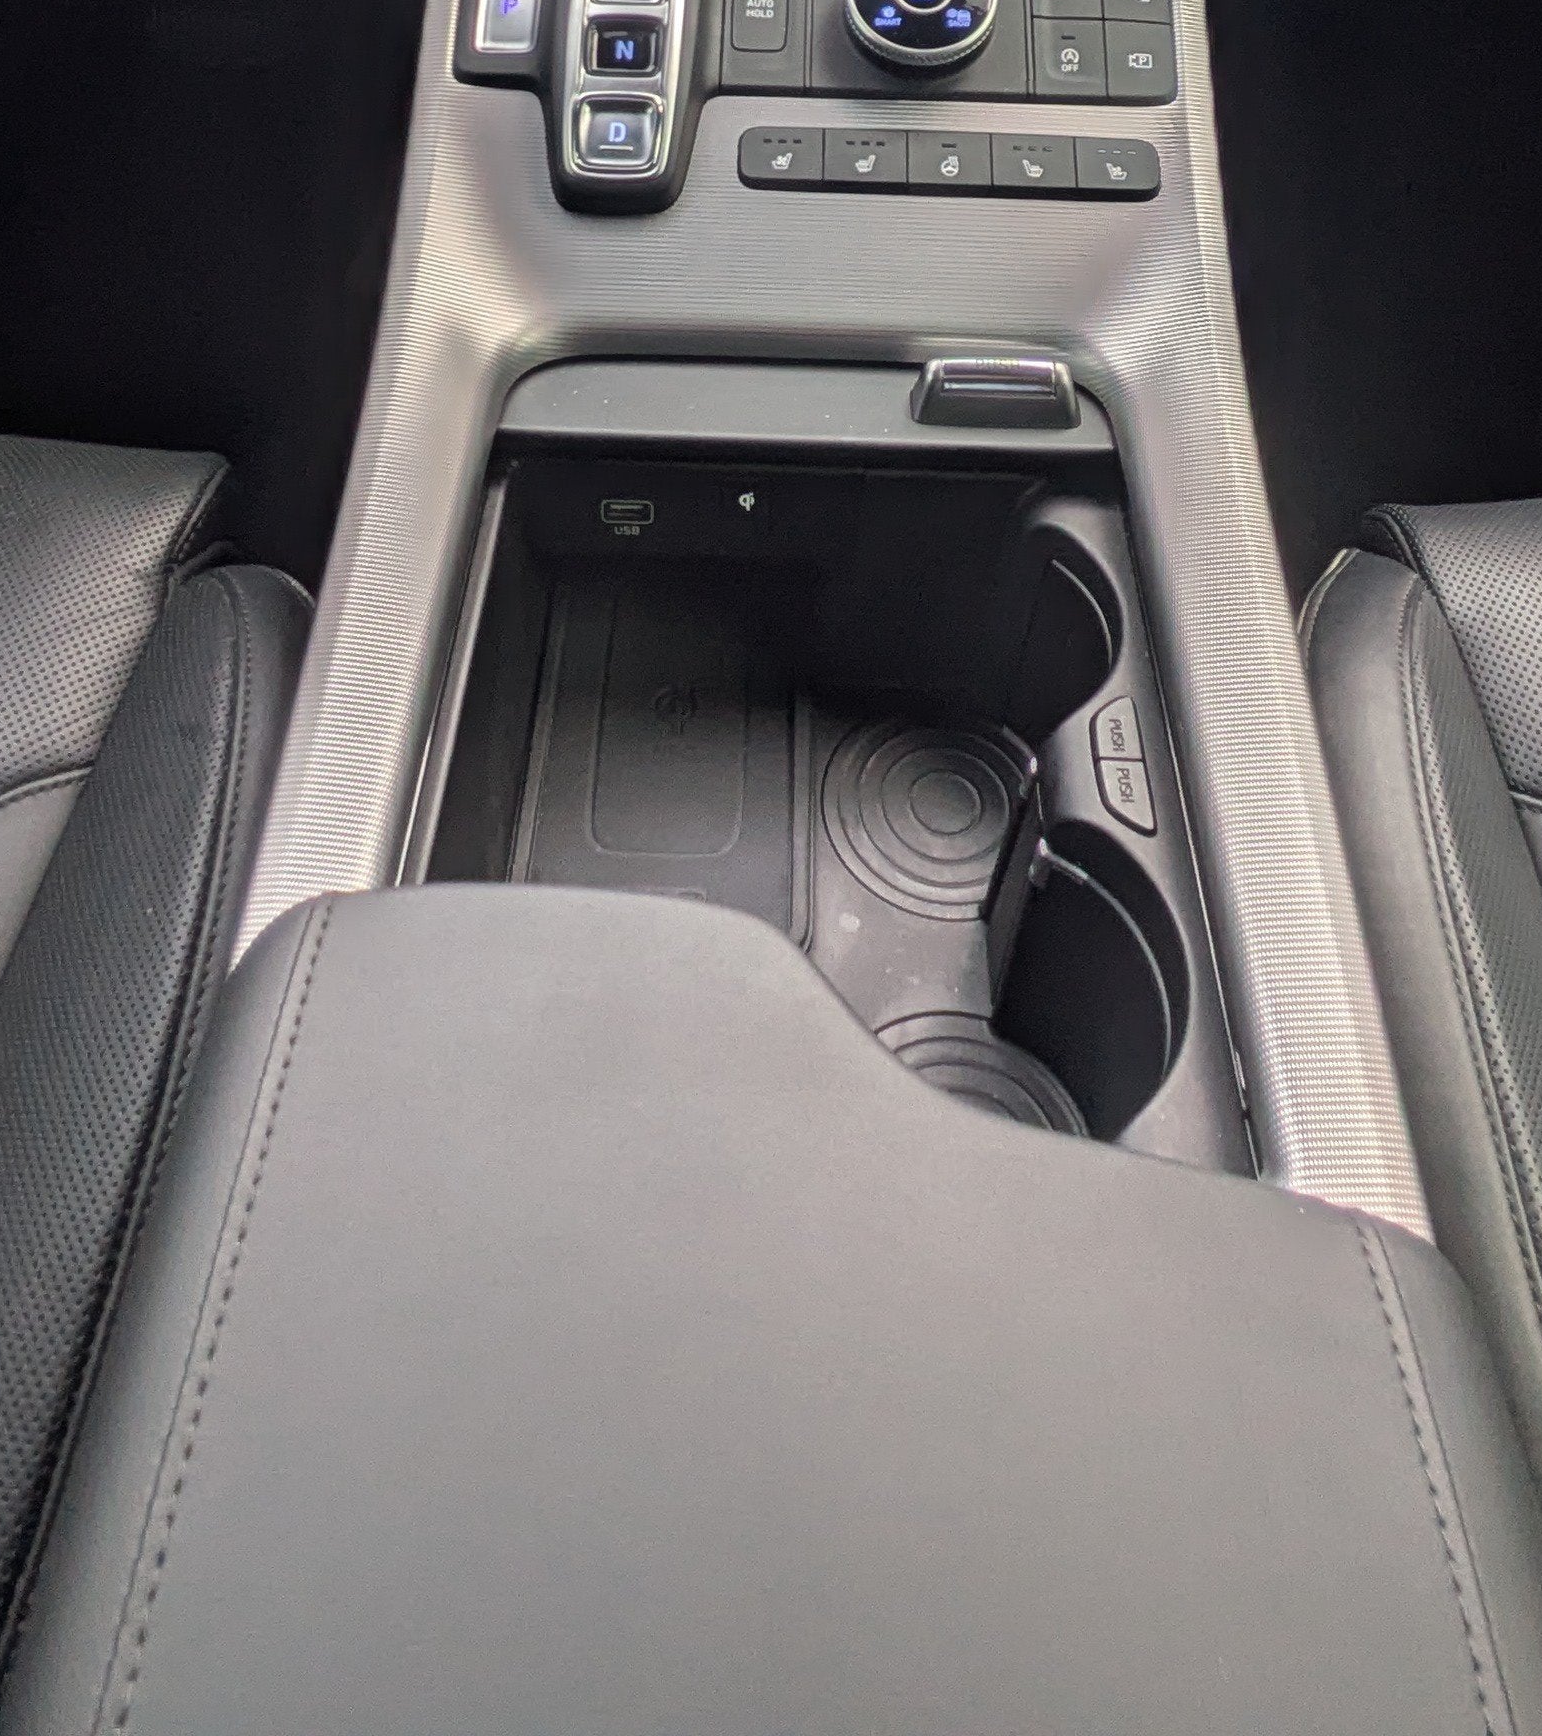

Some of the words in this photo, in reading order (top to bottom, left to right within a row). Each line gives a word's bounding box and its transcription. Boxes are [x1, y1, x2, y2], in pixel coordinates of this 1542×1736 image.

[745, 9, 775, 19] HOLD
[614, 40, 635, 60] N
[1061, 63, 1079, 72] OFF
[609, 121, 628, 143] D
[613, 525, 641, 536] USB
[1109, 718, 1126, 752] PUSH
[1116, 767, 1135, 803] PUSH
